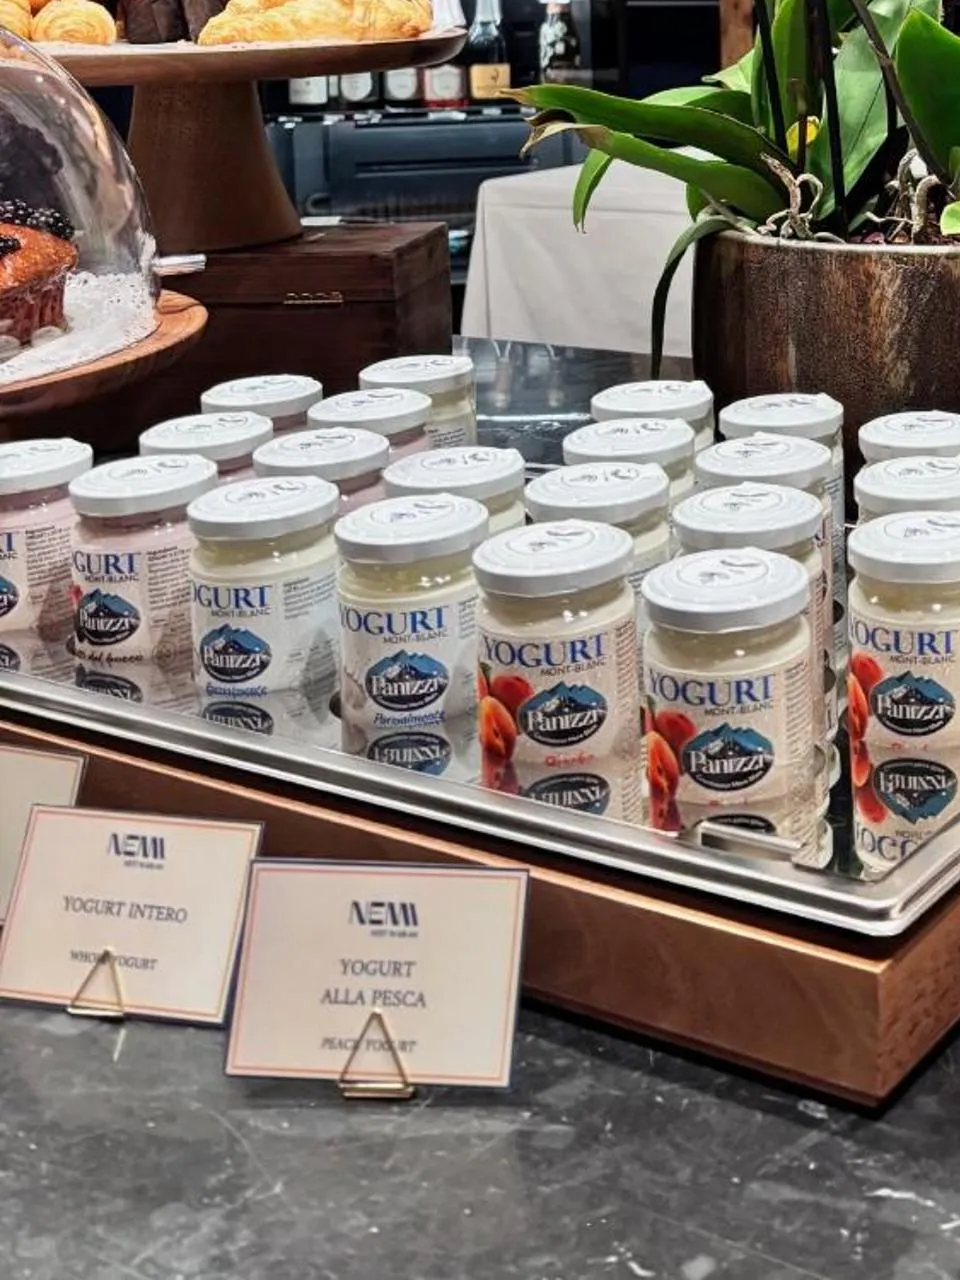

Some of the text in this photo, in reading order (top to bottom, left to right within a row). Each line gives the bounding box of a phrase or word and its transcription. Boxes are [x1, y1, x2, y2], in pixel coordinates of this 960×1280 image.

[72, 551, 140, 575] GURT
[482, 631, 608, 668] YOGURT
[852, 620, 958, 655] OGURT
[649, 668, 776, 707] YOGURT
[63, 895, 188, 923] YOGURT INTERO
[70, 950, 106, 965] WHO
[340, 958, 416, 978] YOGURT
[320, 988, 426, 1008] ALLA PESCA
